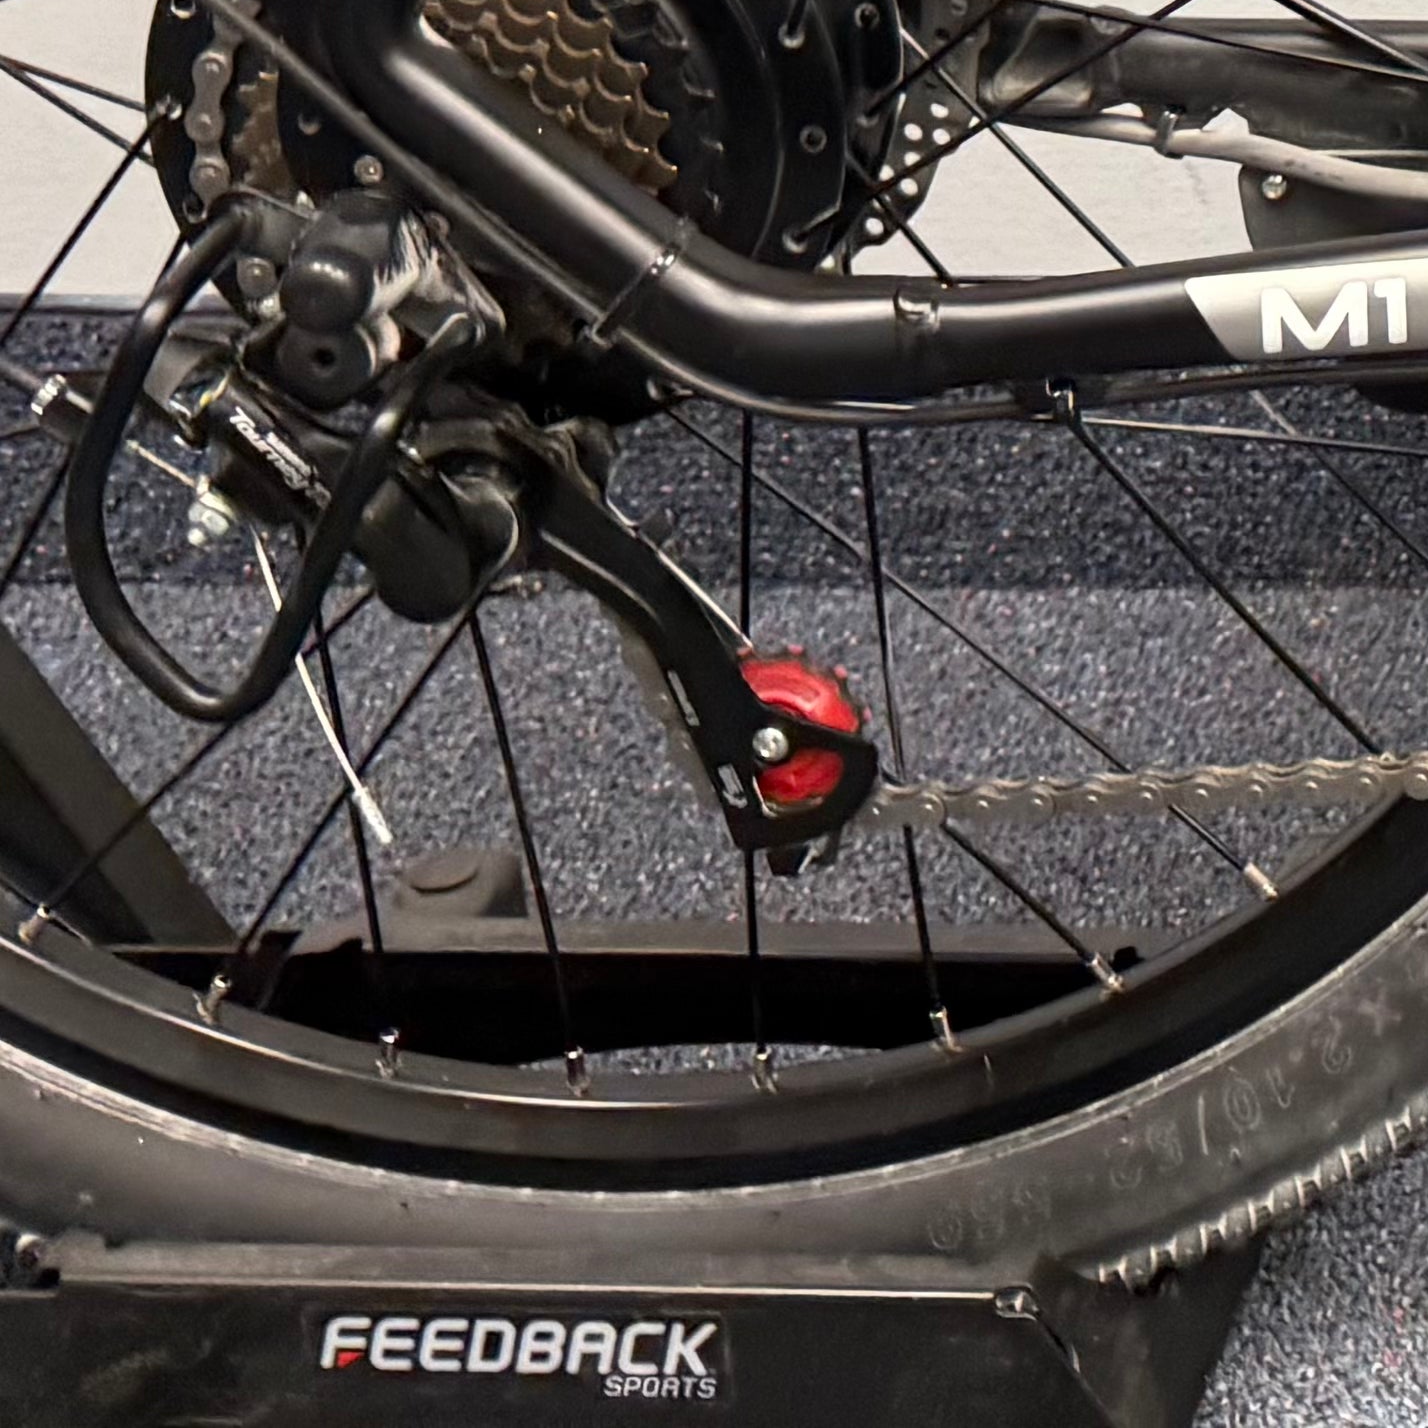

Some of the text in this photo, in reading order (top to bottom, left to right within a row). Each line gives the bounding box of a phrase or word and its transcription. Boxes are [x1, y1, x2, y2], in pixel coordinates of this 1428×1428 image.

[1260, 276, 1408, 355] M1
[229, 405, 310, 491] Tourney
[319, 1316, 718, 1376] FEEDBACK
[602, 1375, 718, 1400] SPORTS
